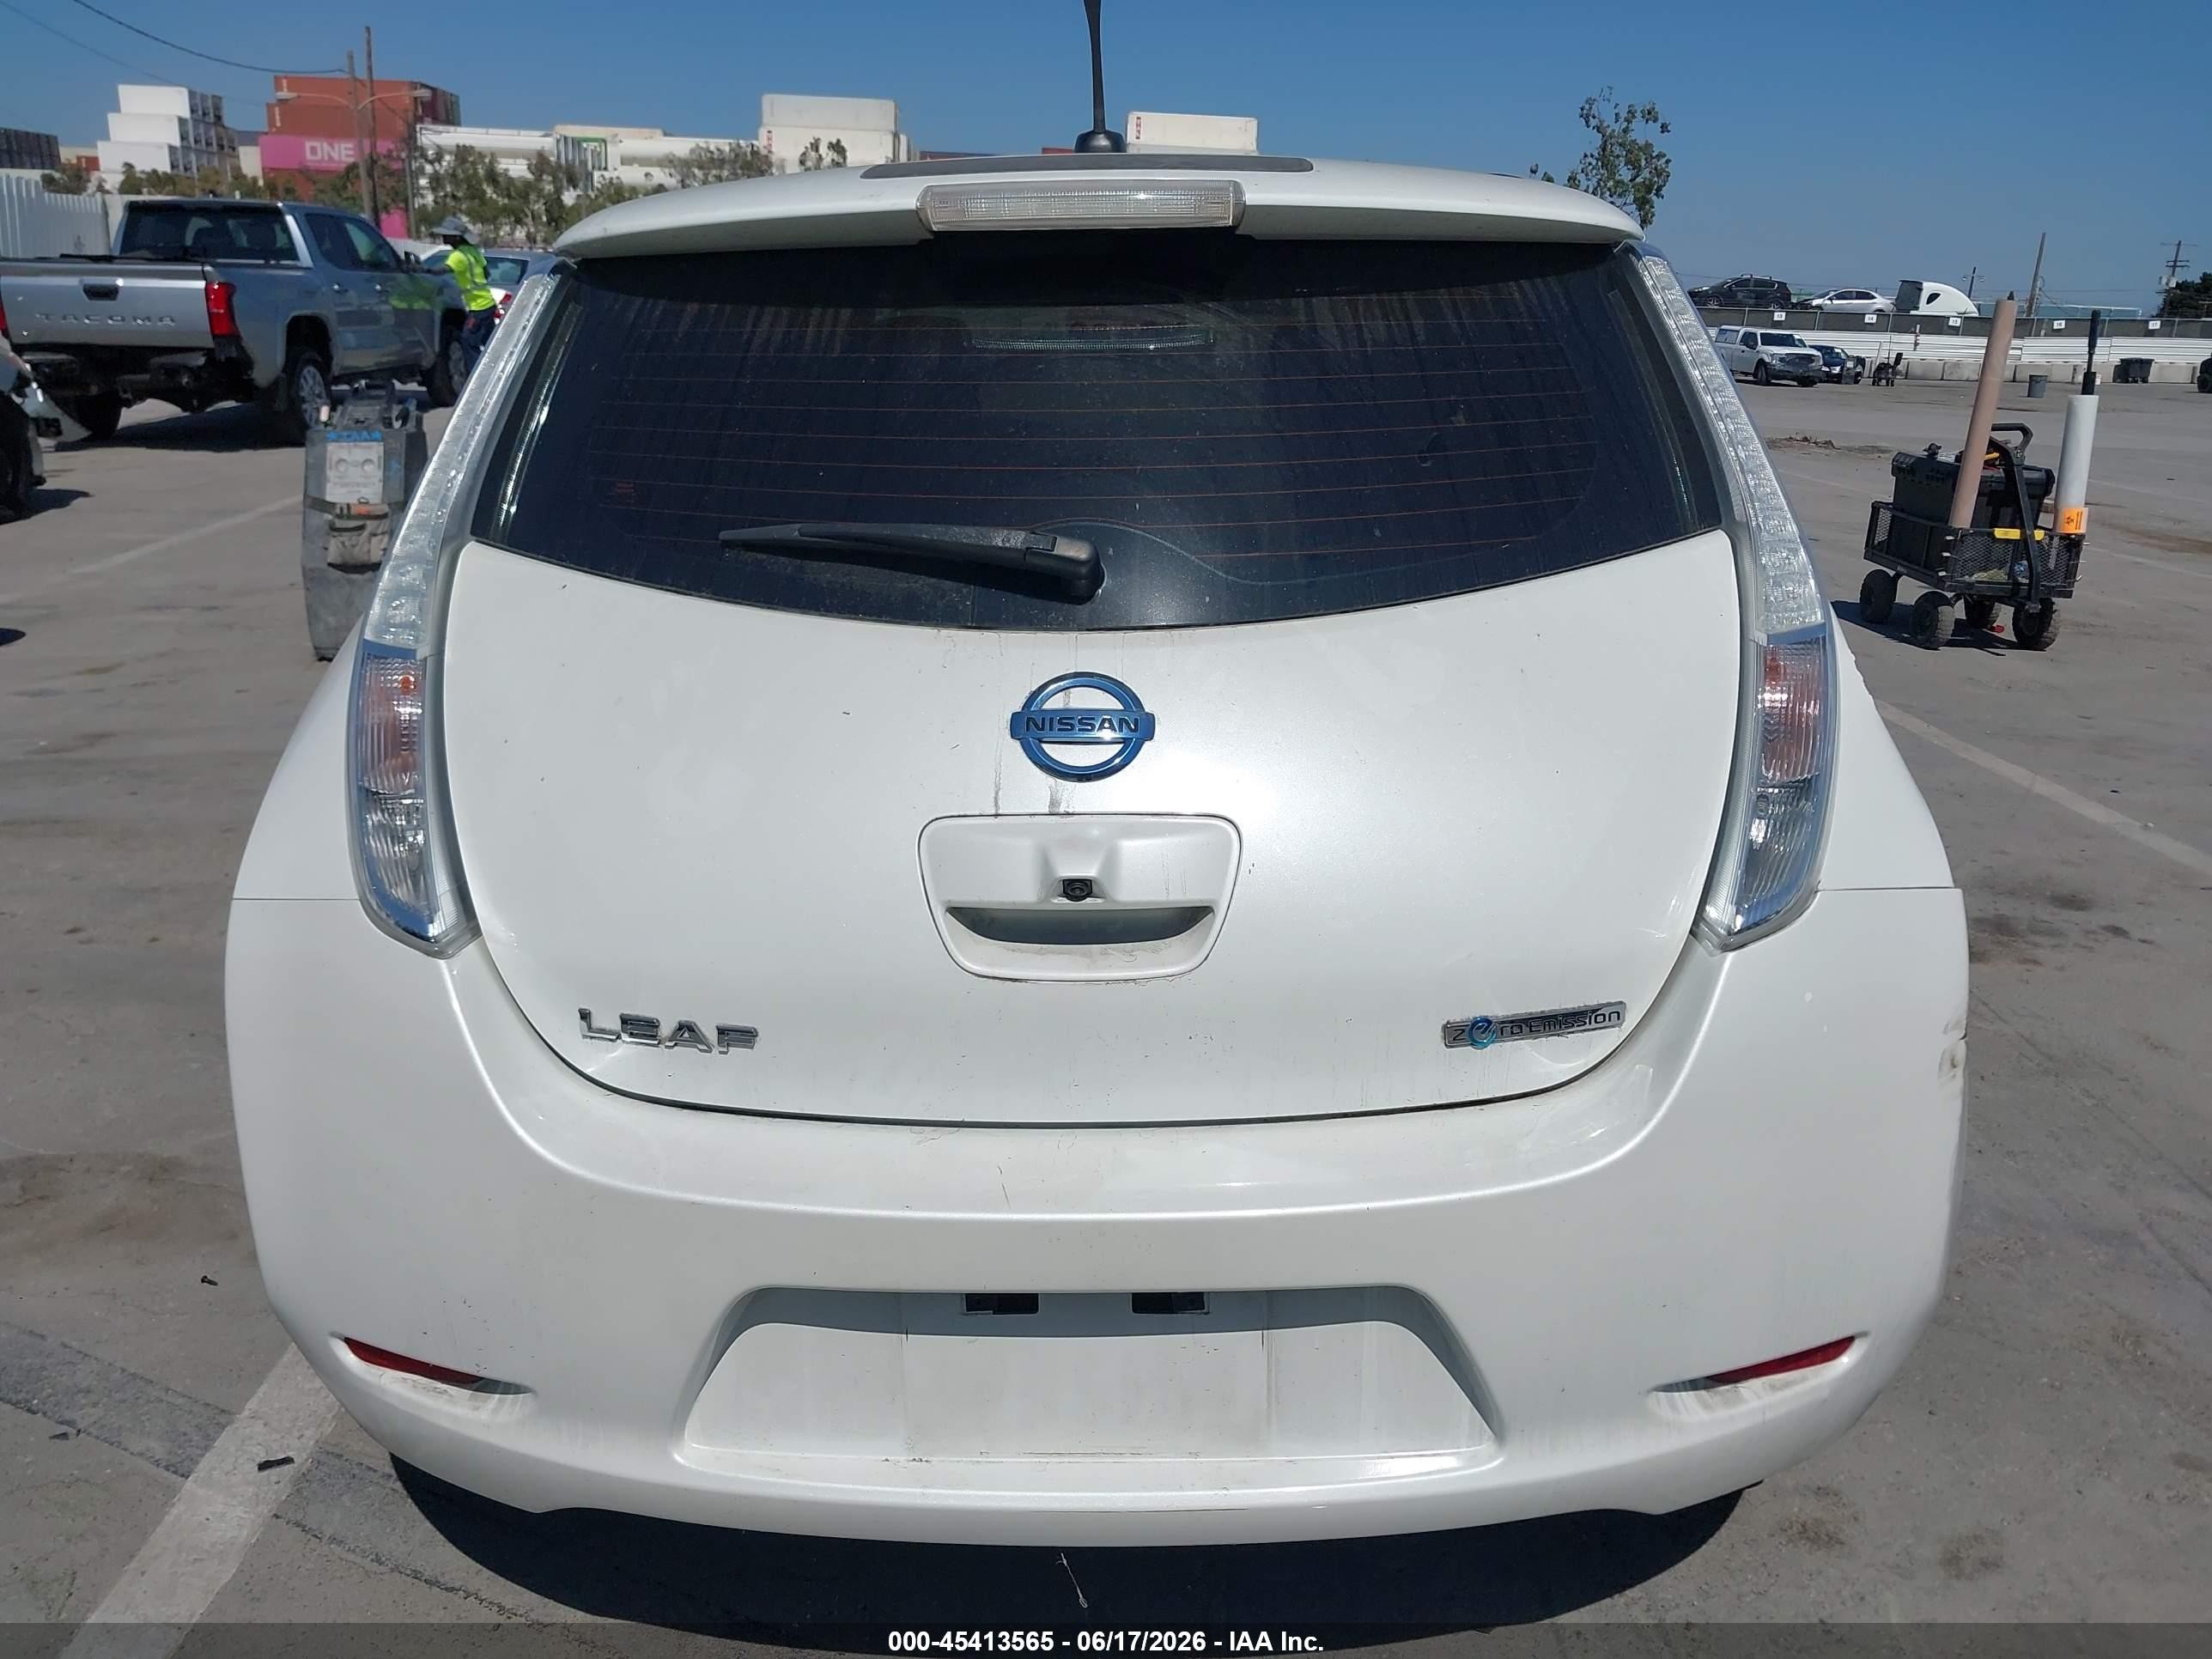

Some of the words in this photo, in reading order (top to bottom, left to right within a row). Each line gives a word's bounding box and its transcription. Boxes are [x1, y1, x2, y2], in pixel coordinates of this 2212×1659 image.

[304, 141, 356, 162] ONE
[34, 313, 175, 326] TACOMA
[1025, 714, 1139, 732] NISSAN
[578, 1008, 758, 1054] LEAF
[1528, 1010, 1621, 1033] Emission
